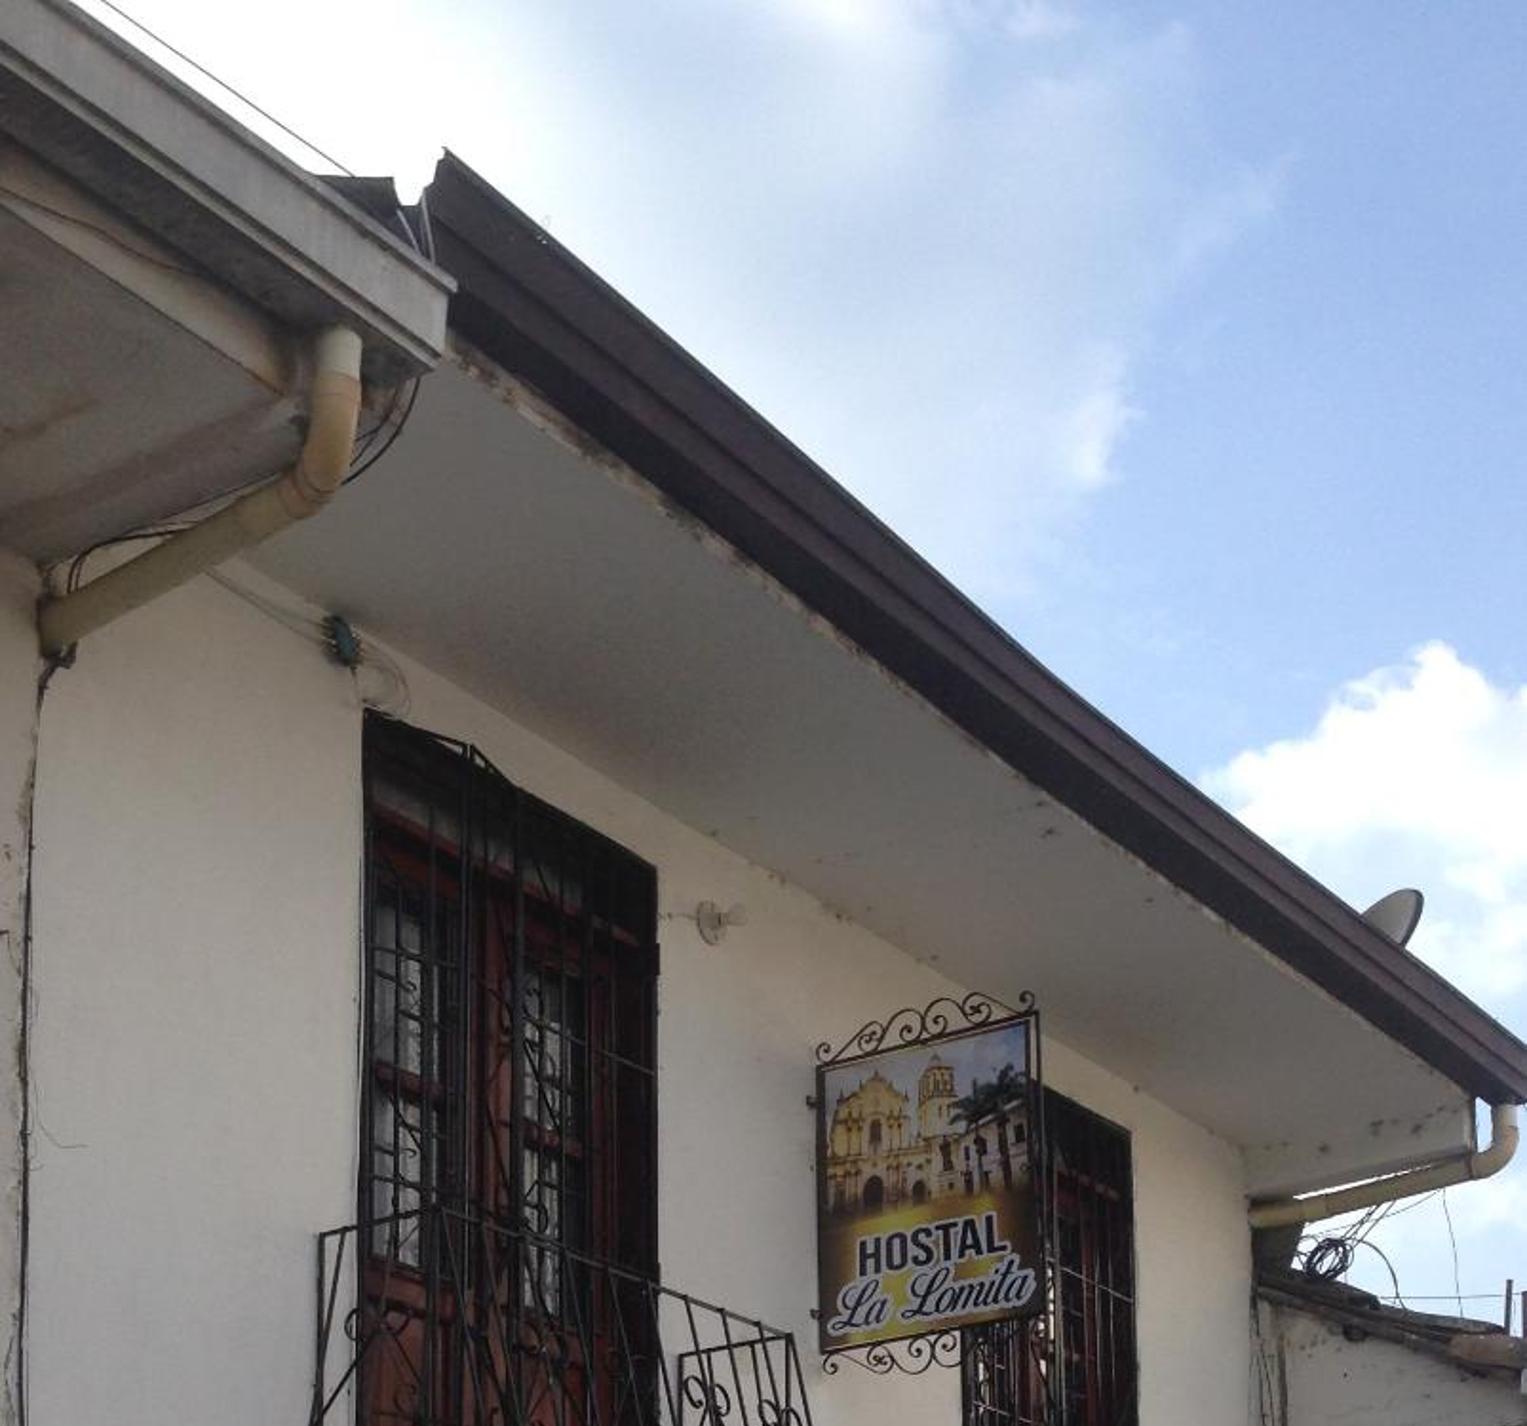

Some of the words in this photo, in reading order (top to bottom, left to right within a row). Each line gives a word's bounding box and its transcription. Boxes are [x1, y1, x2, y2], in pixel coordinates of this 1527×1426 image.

[858, 1214, 1008, 1277] HOSTAL
[832, 1278, 889, 1331] La
[901, 1258, 1033, 1320] Lomita
